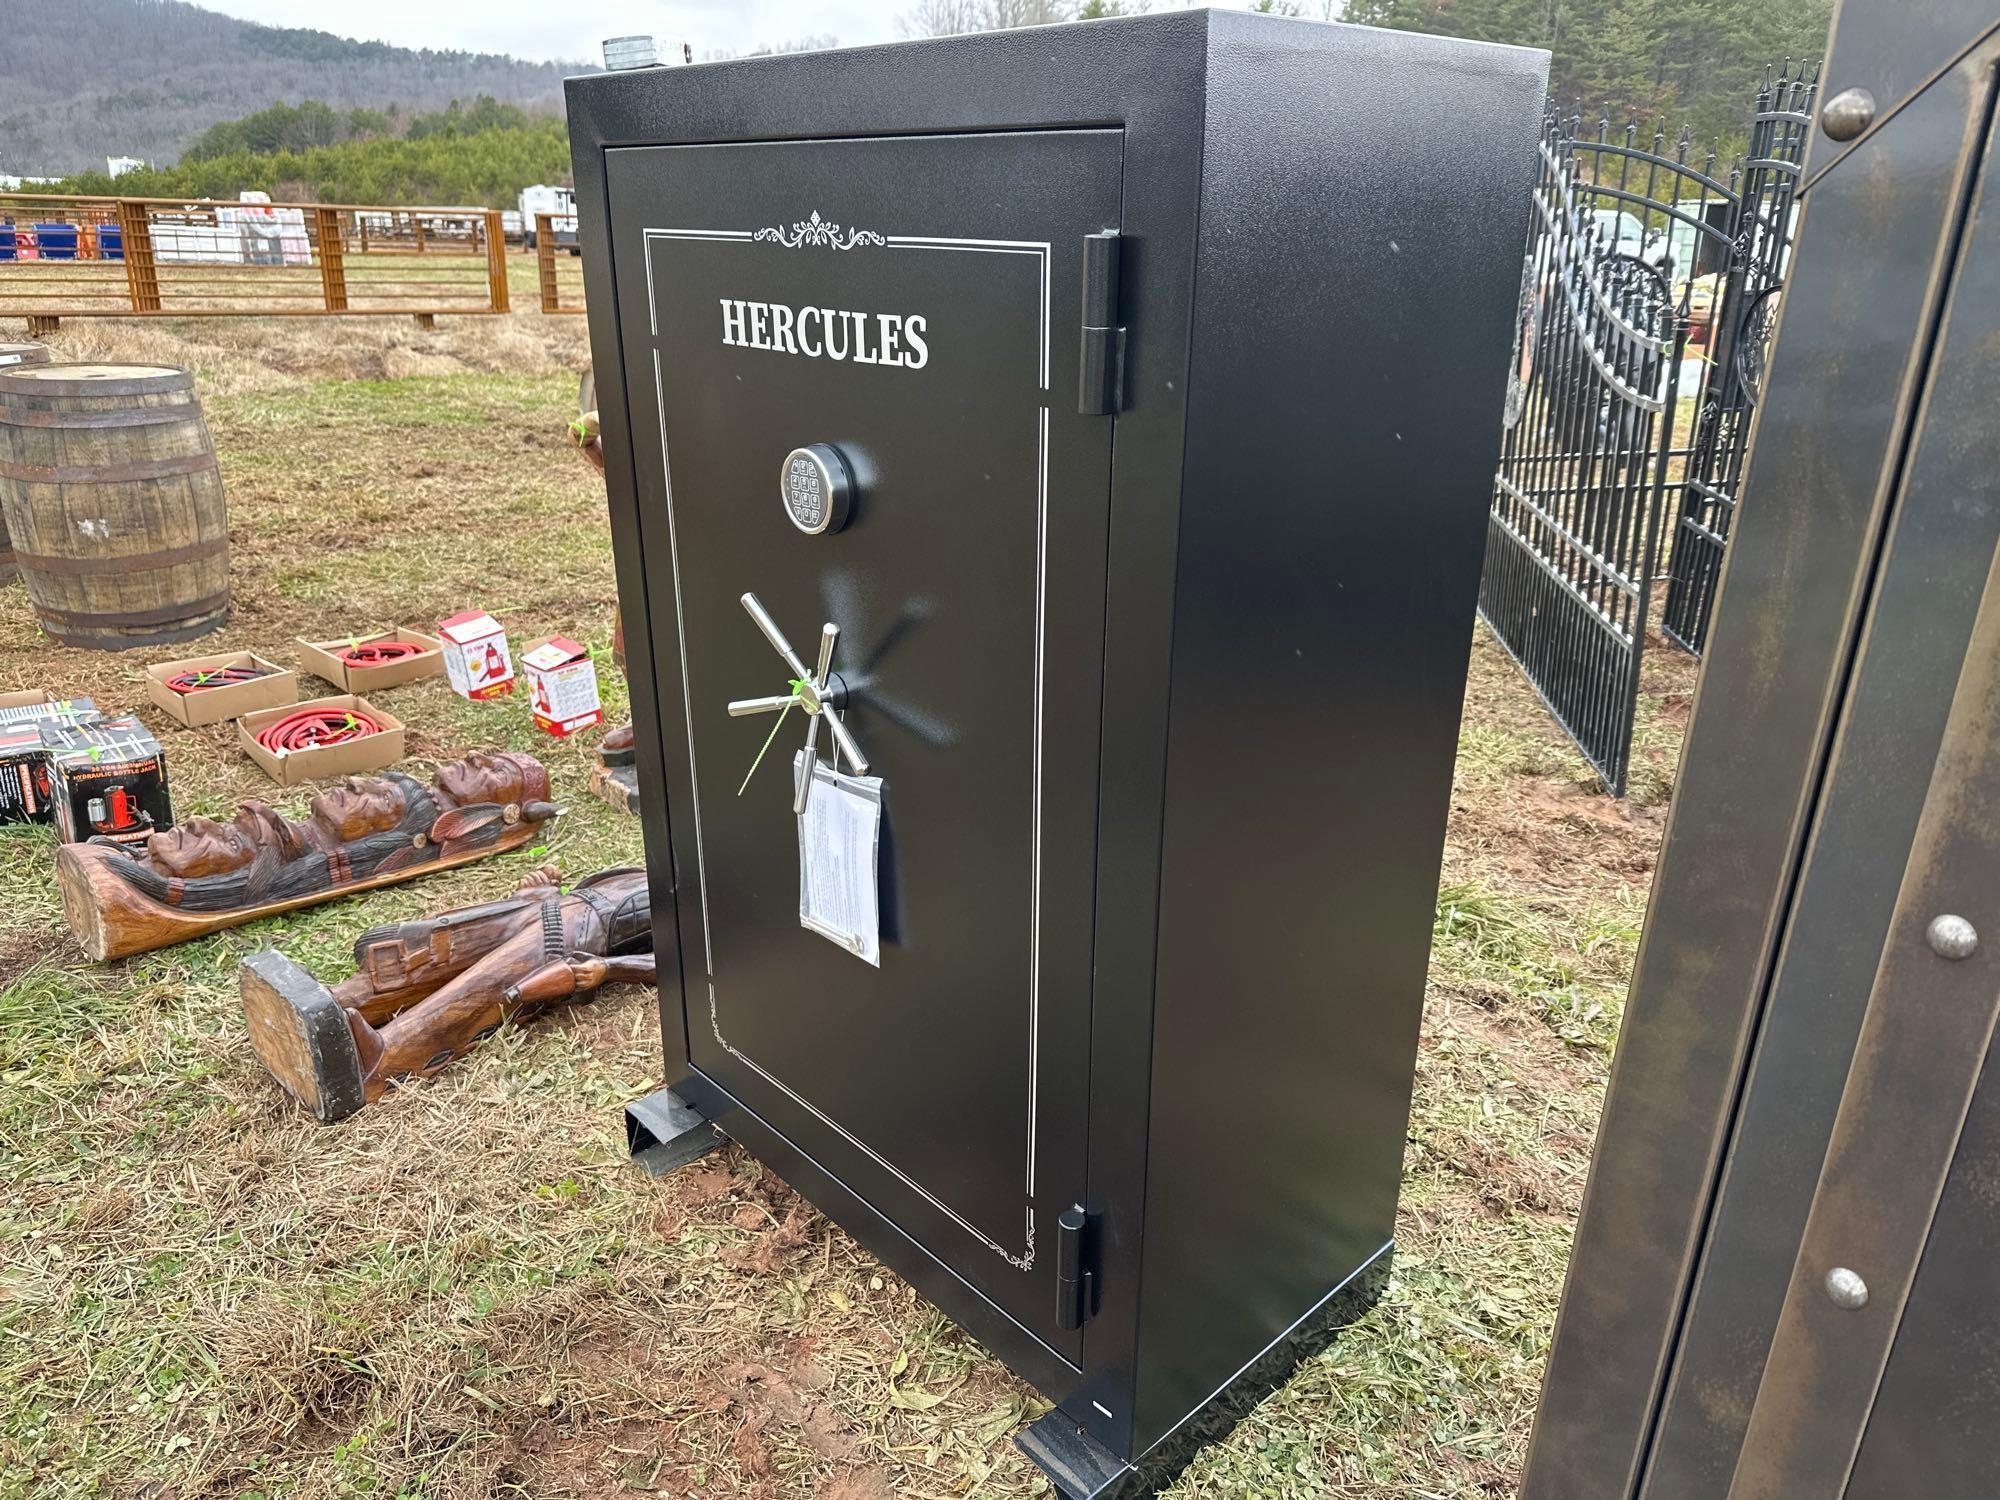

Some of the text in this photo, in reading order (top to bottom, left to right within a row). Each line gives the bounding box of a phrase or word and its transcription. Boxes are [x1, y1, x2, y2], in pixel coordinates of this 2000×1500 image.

[719, 299, 929, 369] HERCULES
[73, 765, 157, 781] HYDRAULIC BOTTLE JACK
